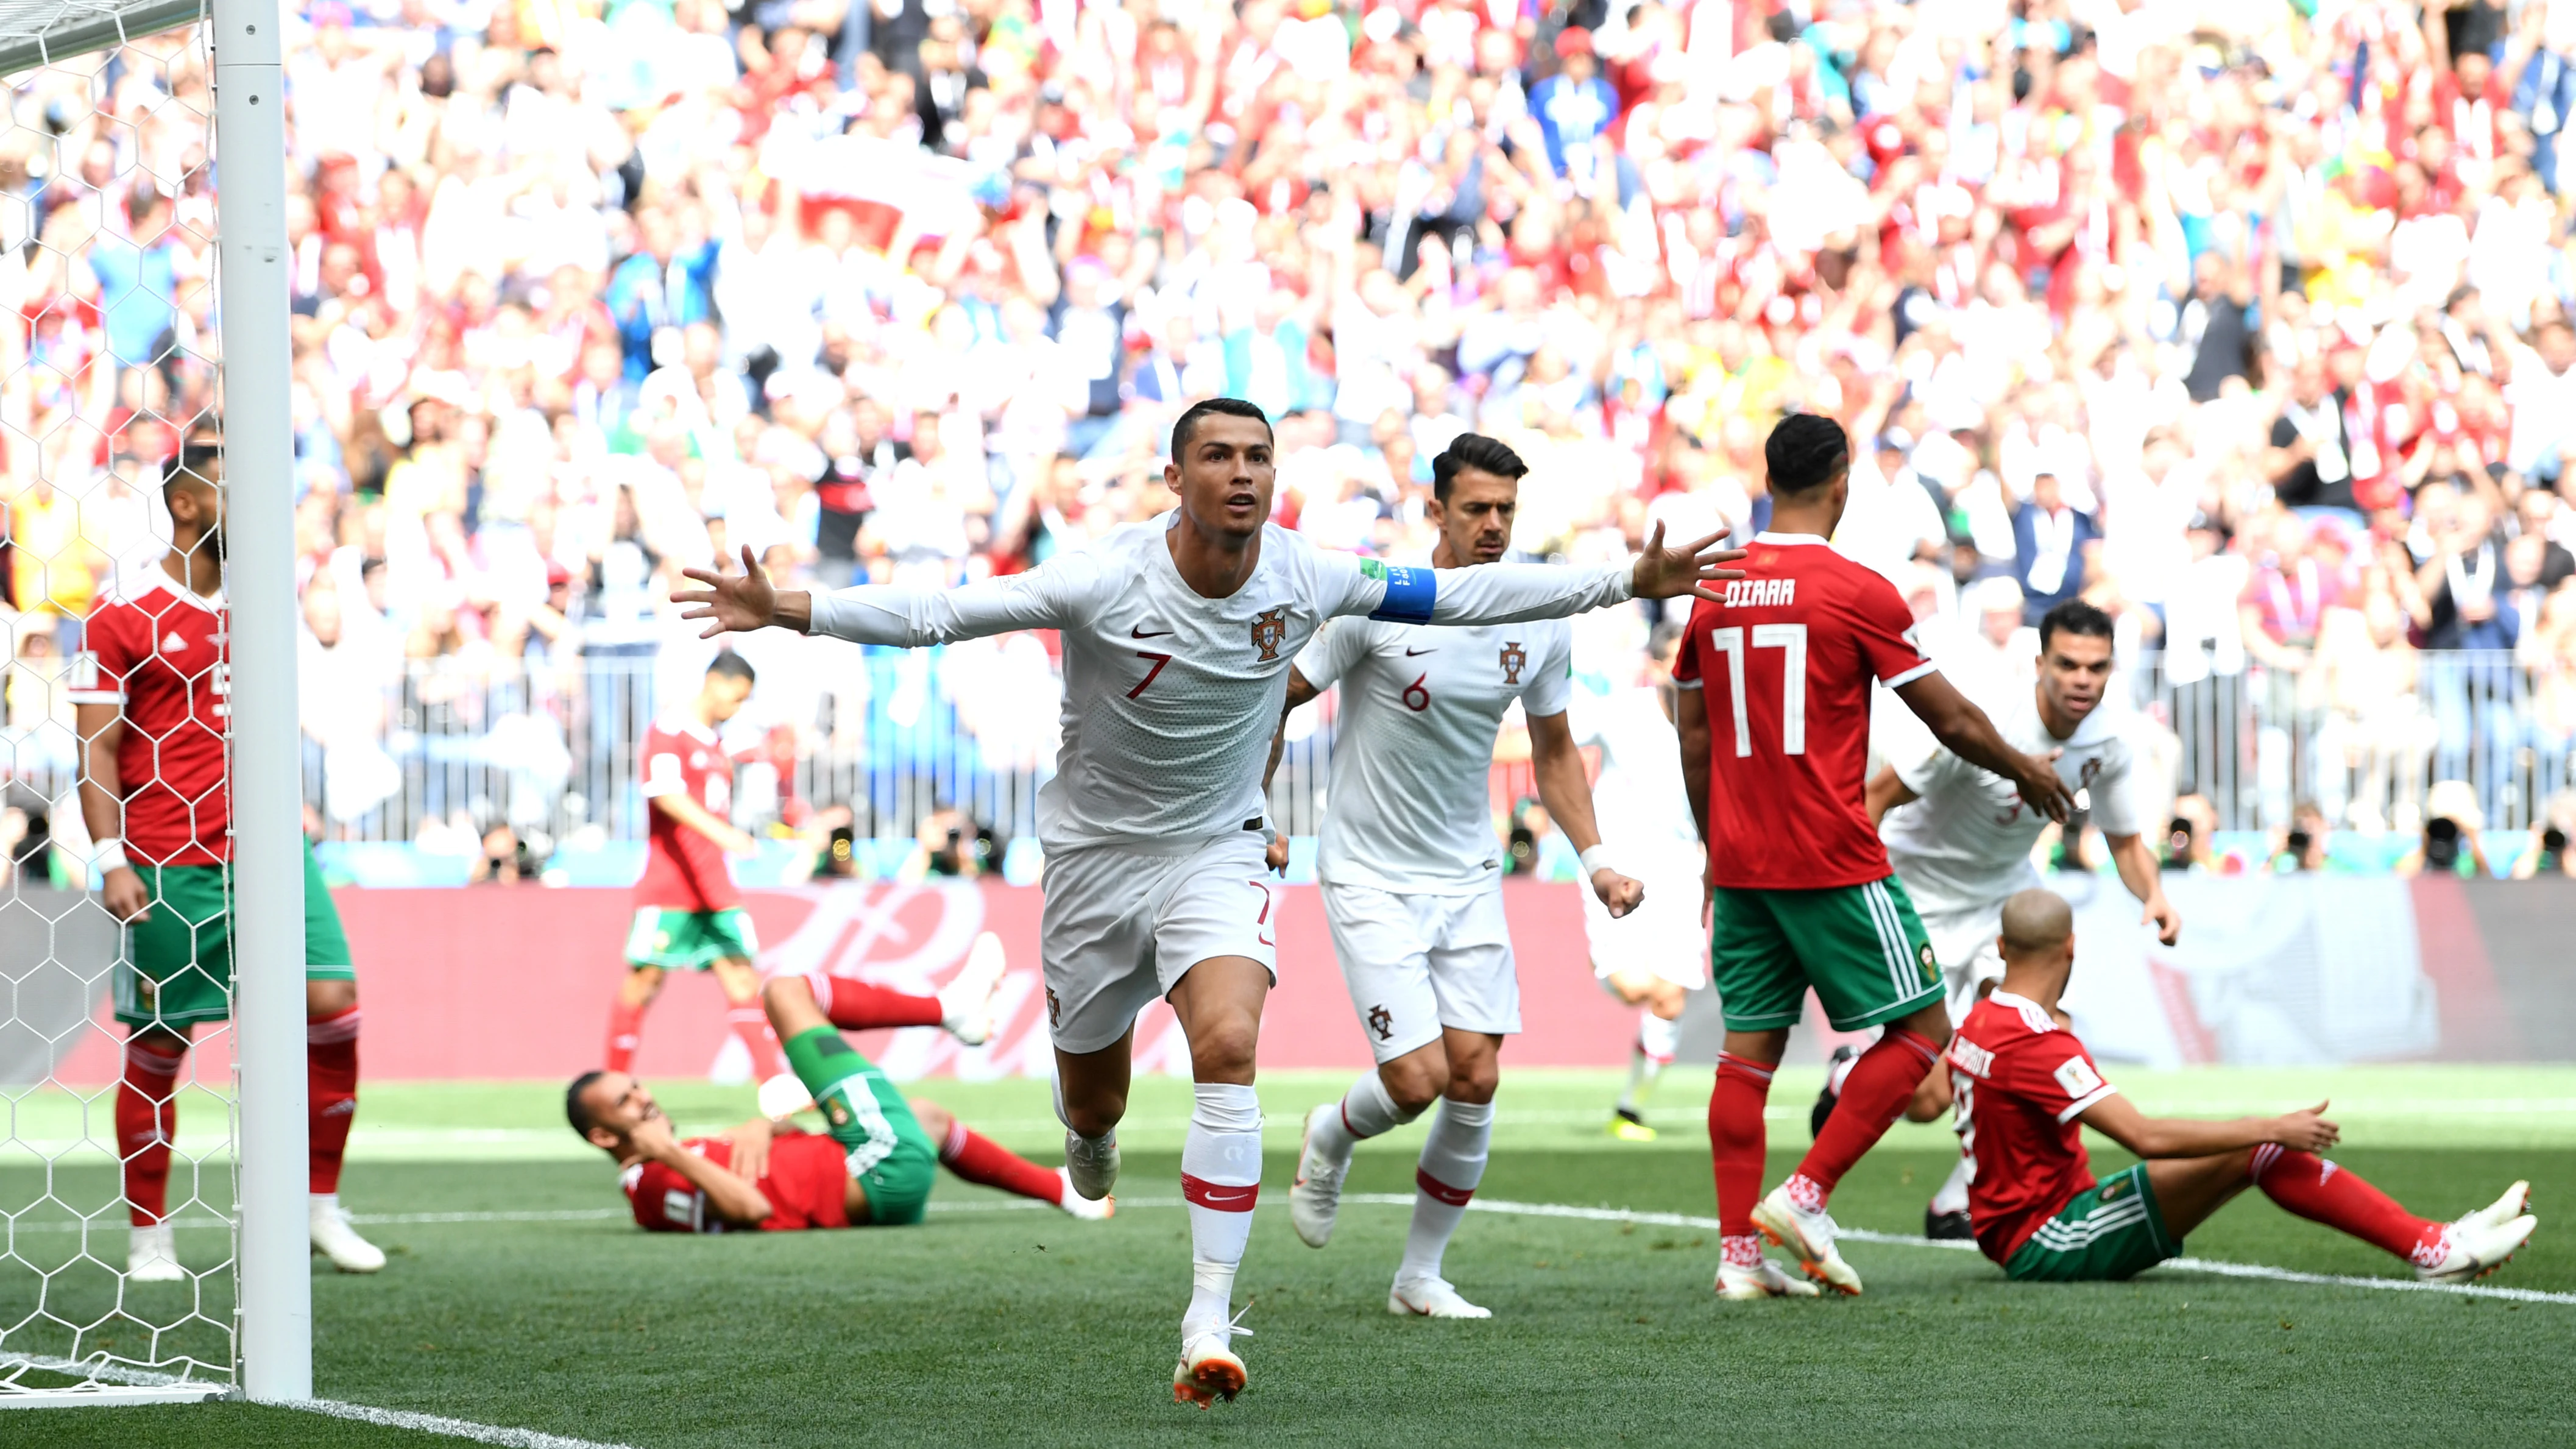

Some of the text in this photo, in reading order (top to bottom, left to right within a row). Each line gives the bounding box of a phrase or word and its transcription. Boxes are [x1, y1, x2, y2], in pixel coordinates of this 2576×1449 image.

[1126, 651, 1172, 700] 7
[1403, 671, 1429, 712] 6
[1711, 623, 1807, 757] 17
[1248, 880, 1270, 926] 7
